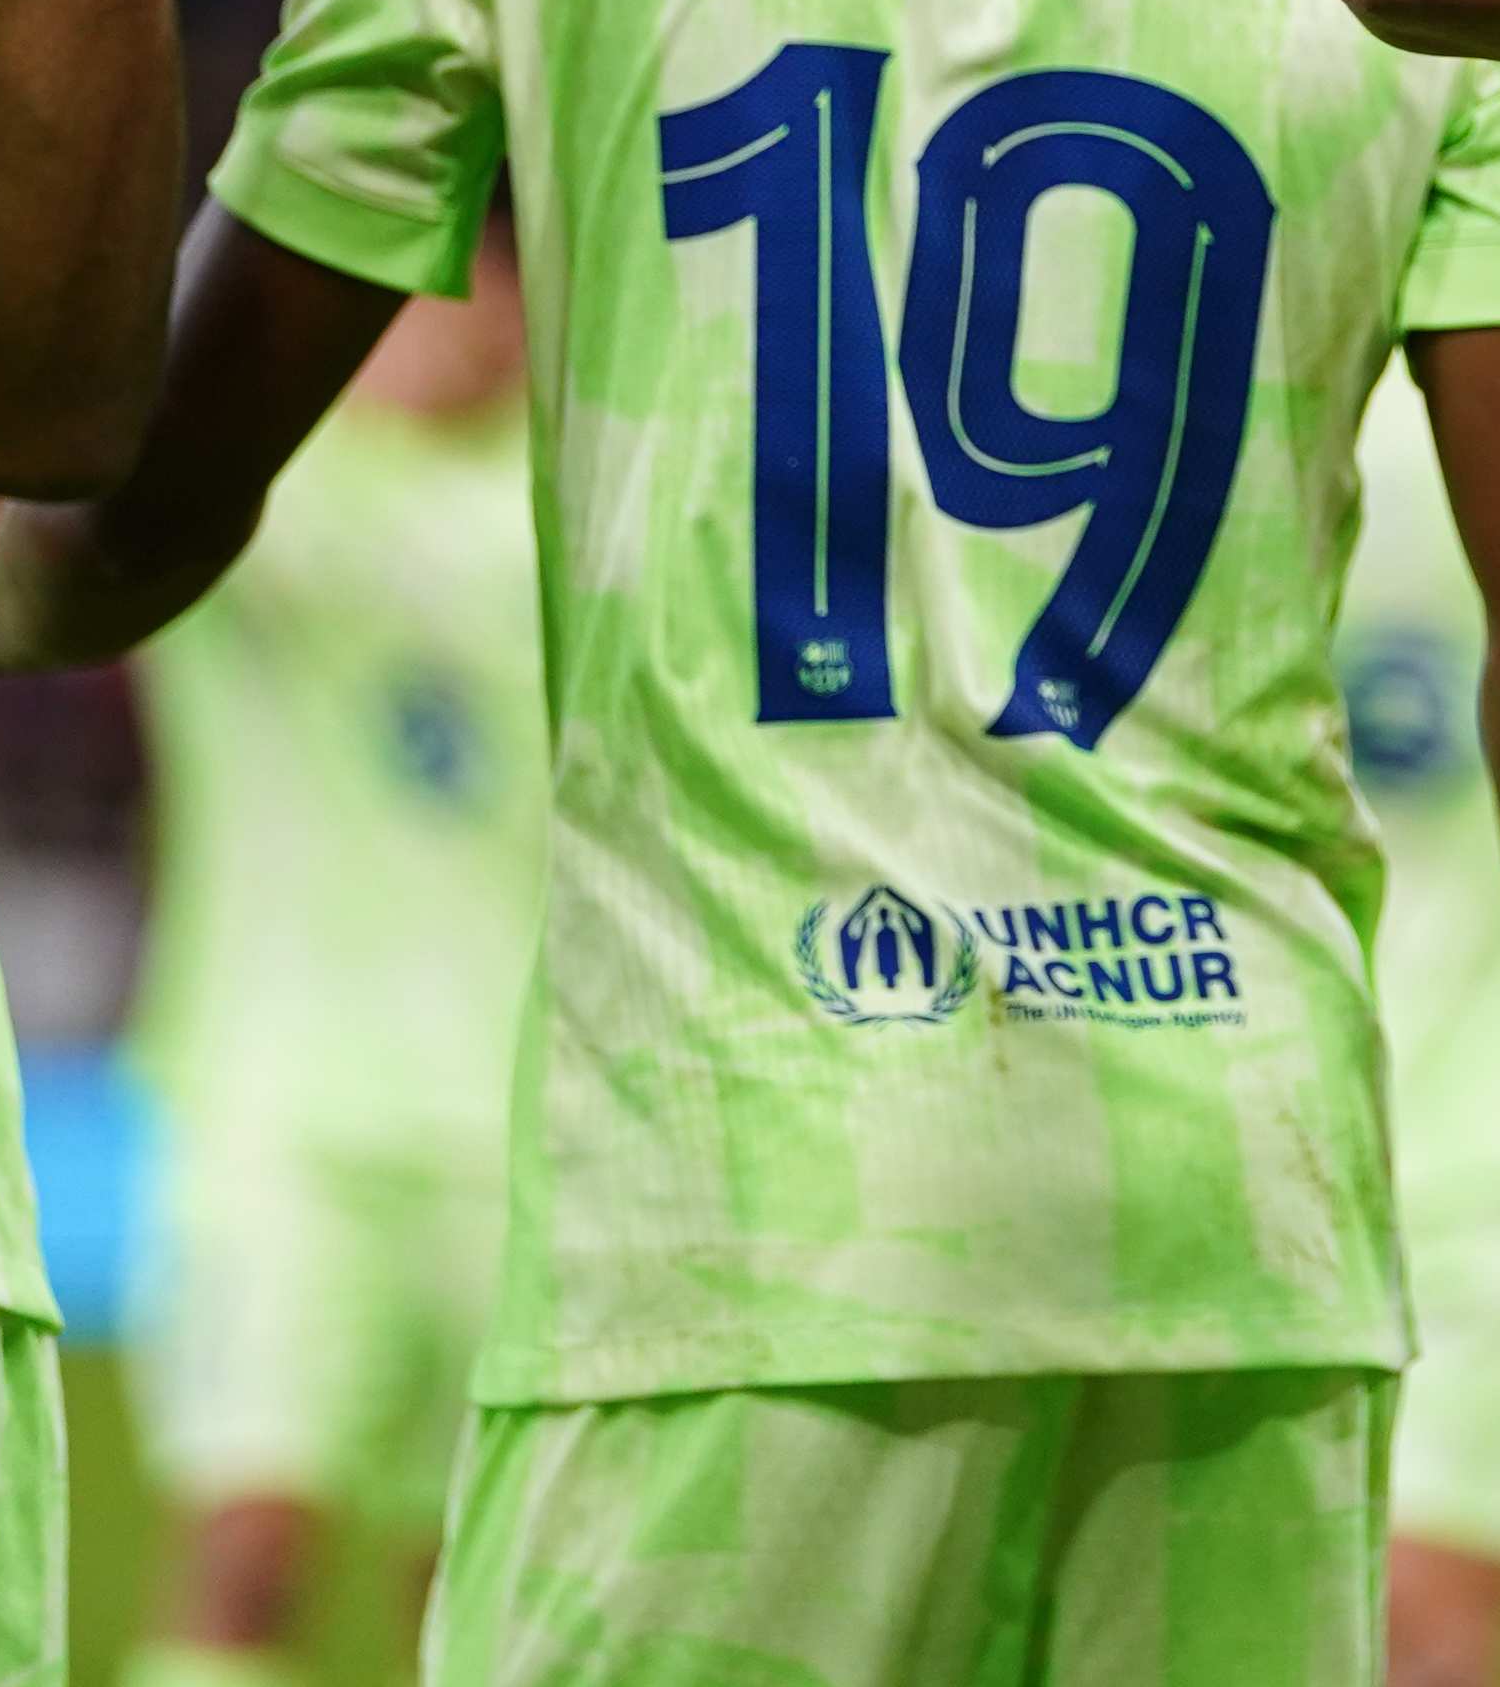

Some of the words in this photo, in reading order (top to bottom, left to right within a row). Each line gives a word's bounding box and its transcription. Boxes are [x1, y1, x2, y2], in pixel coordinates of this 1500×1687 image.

[657, 39, 1279, 753] 19
[974, 894, 1227, 953] UNHCR
[1003, 950, 1240, 1005] ACNUR
